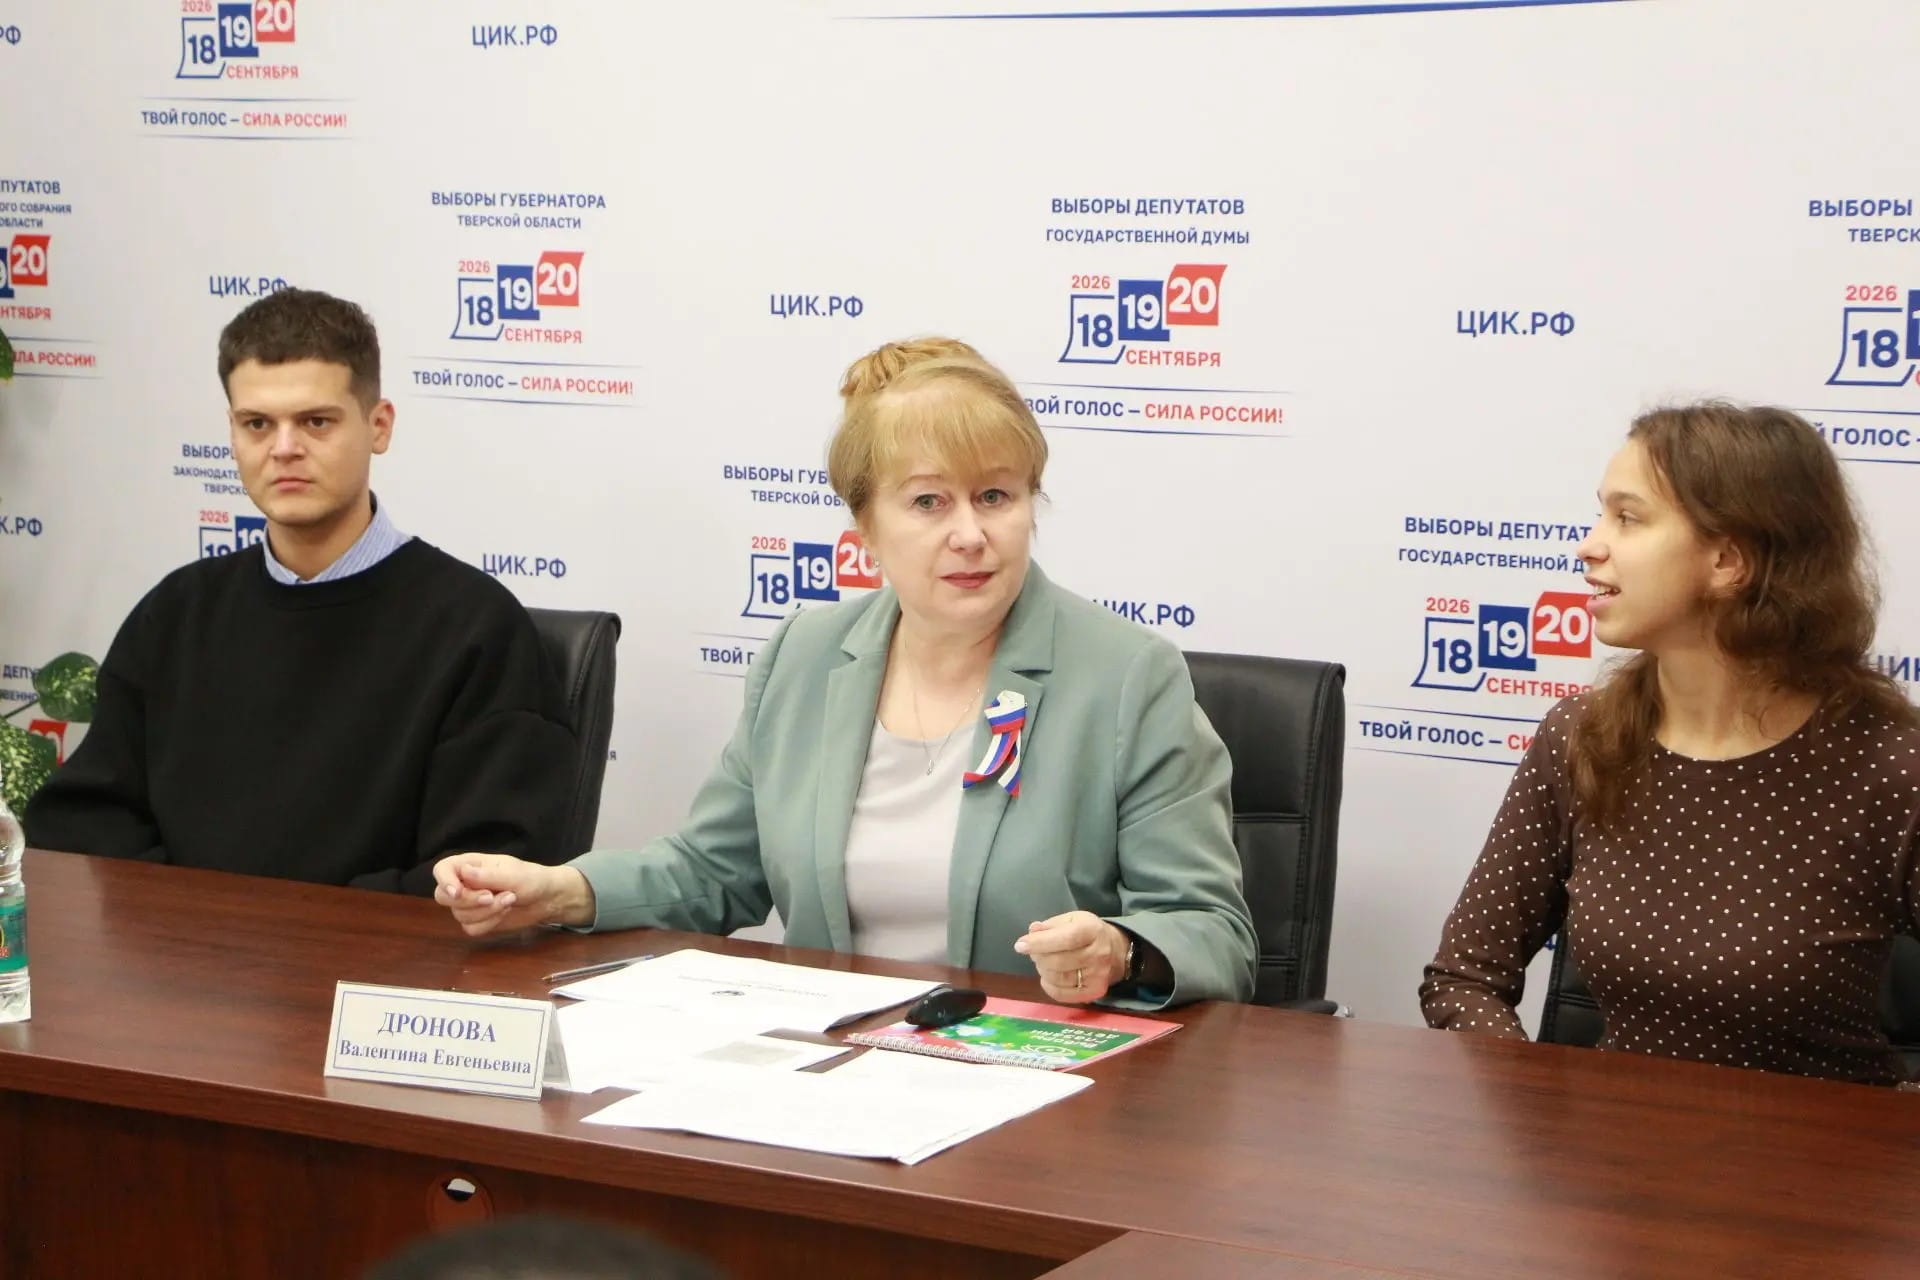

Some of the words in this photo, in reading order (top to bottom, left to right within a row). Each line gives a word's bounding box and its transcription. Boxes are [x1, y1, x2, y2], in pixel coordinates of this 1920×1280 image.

[182, 0, 212, 12] 2026
[188, 34, 216, 64] 18
[221, 15, 251, 48] 19
[257, 0, 293, 32] 20
[472, 24, 558, 50] ЦИК.РФ
[226, 65, 298, 79] СЕНТЯБРЯ
[141, 109, 178, 125] ТВОЙ
[182, 112, 227, 126] ГОЛОС
[243, 113, 281, 127] СИЛА
[285, 114, 347, 128] РОССИИ!
[20, 203, 72, 214] СОБРАНИЯ
[431, 191, 496, 207] ВЫБОРЫ
[500, 193, 607, 209] ГУБЕРНАТОРА
[1051, 197, 1131, 214] ВЫБОРЫ
[1135, 199, 1245, 217] ДЕПУТАТОВ
[1808, 199, 1913, 217] ВЫБОРЫ
[457, 213, 520, 228] ТВЕРСКОЙ
[524, 216, 582, 229] ОБЛАСТИ
[1046, 227, 1198, 245] ГОСУДАРСТВЕННОЙ
[1201, 230, 1250, 246] ДУМЫ
[1848, 228, 1920, 242] ТВЕРСК
[13, 244, 45, 276] 20
[458, 260, 490, 273] 2026
[1071, 275, 1111, 290] 2026
[464, 296, 494, 326] 18
[500, 278, 532, 311] 19
[538, 263, 578, 297] 20
[1845, 285, 1897, 302] 2026
[770, 293, 864, 319] ЦИК.РФ
[1077, 314, 1114, 348] 18
[1122, 294, 1161, 330] 19
[1169, 276, 1217, 314] 20
[1456, 310, 1576, 337] ЦИК.РФ
[504, 328, 582, 344] СЕНТЯБРЯ
[1125, 349, 1221, 367] СЕНТЯБРЯ
[1852, 329, 1900, 368] 18
[38, 352, 96, 367] РОССИИ!
[413, 369, 451, 386] ТВОЙ
[456, 373, 504, 388] ГОЛОС
[521, 376, 562, 391] СИЛА
[566, 378, 633, 395] РОССИИ!
[1065, 399, 1124, 417] ГОЛОС
[1145, 403, 1195, 421] СИЛА
[1199, 406, 1283, 424] РОССИИ!
[1832, 427, 1911, 447] ГОЛОС
[723, 465, 793, 482] ВЫБОРЫ
[751, 489, 820, 506] ТВЕРСКОЙ
[199, 510, 229, 524] 2026
[1404, 516, 1493, 537] ВЫБОРЫ
[752, 536, 786, 551] 2026
[482, 552, 566, 579] ЦИК.РФ
[1398, 548, 1569, 572] ГОСУДАРСТВЕННОЙ
[757, 572, 790, 605] 18
[797, 556, 831, 591] 19
[1426, 597, 1470, 614] 2026
[1432, 638, 1473, 674] 18
[1483, 620, 1526, 658] 19
[1535, 604, 1589, 645] 20
[700, 645, 743, 665] ТВОЙ
[1359, 720, 1412, 741] ТВОЙ
[1417, 726, 1484, 747] ГОЛОС
[378, 1011, 497, 1043] ДРОНОВА
[340, 1039, 428, 1064] Валентина
[433, 1049, 532, 1075] Евгеньевна
